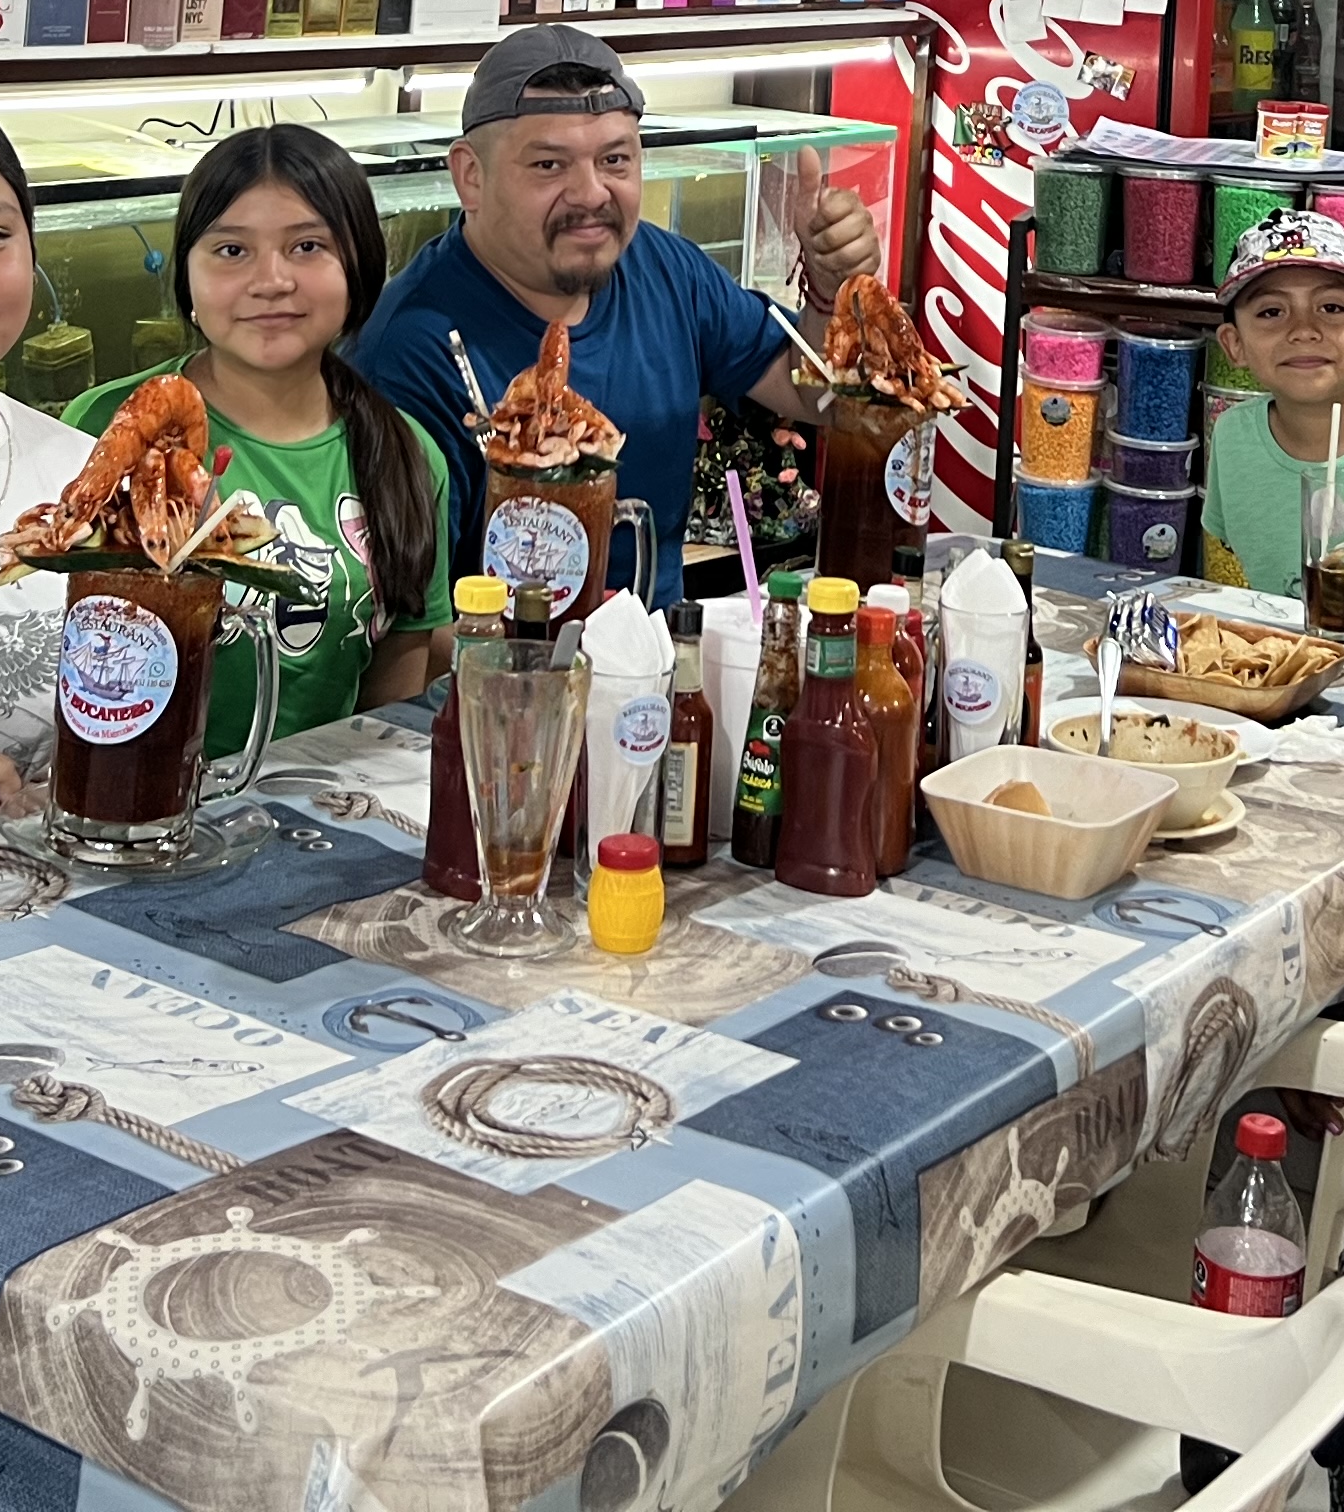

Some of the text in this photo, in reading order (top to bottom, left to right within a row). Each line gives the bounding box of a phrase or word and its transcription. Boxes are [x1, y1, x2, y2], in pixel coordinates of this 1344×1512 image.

[184, 11, 204, 25] NYC
[502, 516, 577, 546] RESTAURANT
[76, 618, 158, 652] RESTAURANT
[947, 666, 993, 682] RESTAURANT
[71, 692, 155, 722] BUCANERO
[622, 702, 668, 718] RESTAURANT
[955, 699, 992, 713] BUCANERO
[770, 719, 779, 731] 2
[88, 966, 286, 1048] OCEAN
[550, 994, 670, 1046] SEA
[237, 1129, 402, 1210] BOAT
